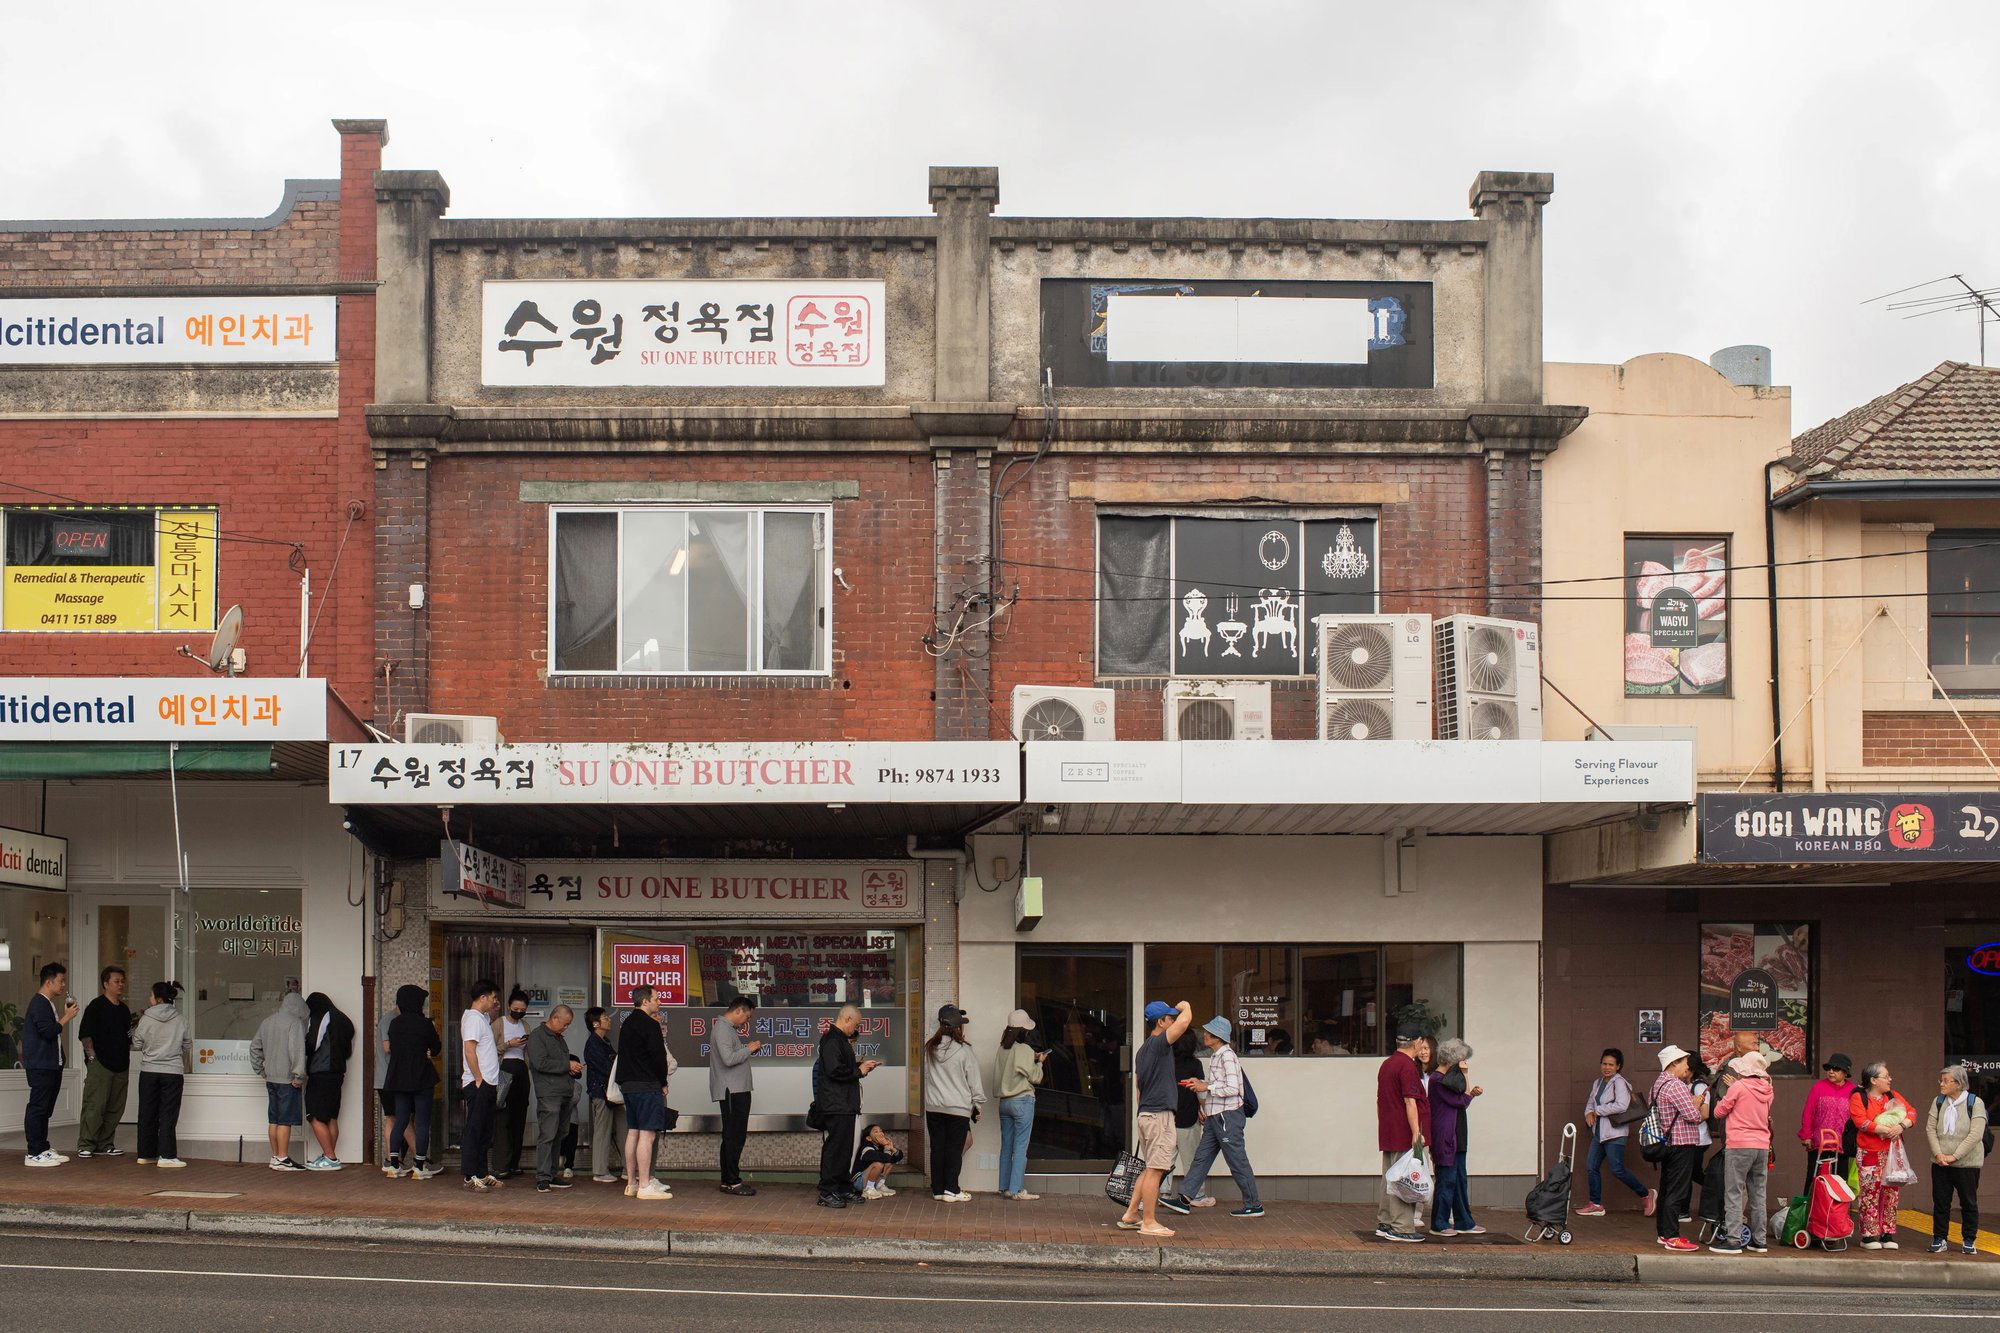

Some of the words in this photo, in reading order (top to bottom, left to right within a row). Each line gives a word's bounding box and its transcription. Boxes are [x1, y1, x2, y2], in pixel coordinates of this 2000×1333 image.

[794, 301, 862, 338] 수원
[186, 314, 314, 346] 예인치과
[641, 350, 663, 366] SU
[664, 350, 699, 366] ONE
[702, 350, 778, 366] BUTCHER
[794, 340, 862, 364] 정육점
[56, 531, 108, 549] OPEN
[14, 573, 67, 583] Remedial
[69, 573, 78, 583] &
[80, 573, 146, 586] Therapeutic
[169, 522, 201, 621] 정통마사지
[54, 593, 104, 605] Massage
[41, 614, 69, 625] 0411
[73, 614, 92, 625] 151
[95, 614, 117, 625] 889
[1660, 615, 1688, 627] WAGYU
[1526, 632, 1536, 640] LG
[158, 694, 281, 726] 예인치과
[337, 749, 363, 769] 17
[1574, 759, 1616, 773] Serving
[1618, 759, 1658, 769] Flavour
[559, 760, 600, 786] SU
[609, 760, 682, 786] ONE
[692, 759, 856, 786] BUTCHER
[877, 768, 909, 784] Ph:
[915, 768, 956, 784] 9874
[961, 768, 1002, 784] 1933
[1066, 767, 1103, 776] ZEST
[1584, 775, 1649, 788] Experiences
[1735, 811, 1792, 837] GOGI
[1802, 807, 1882, 837] WANG
[1795, 840, 1849, 851] KOREAN
[1854, 840, 1882, 851] BBQ
[26, 848, 62, 877] dental
[598, 875, 634, 899] SU
[641, 875, 702, 899] ONE
[710, 876, 850, 900] BUTCHER
[222, 938, 300, 958] 예인치과
[695, 935, 761, 950] PREMIUM
[766, 935, 808, 950] MEAT
[813, 935, 895, 950] SPECIALIST
[619, 971, 681, 986] BUTCHER
[1739, 997, 1768, 1009] WAGYU
[1251, 1011, 1279, 1020] Instagram
[756, 1017, 811, 1038] 최고급
[775, 1043, 815, 1057] BEST
